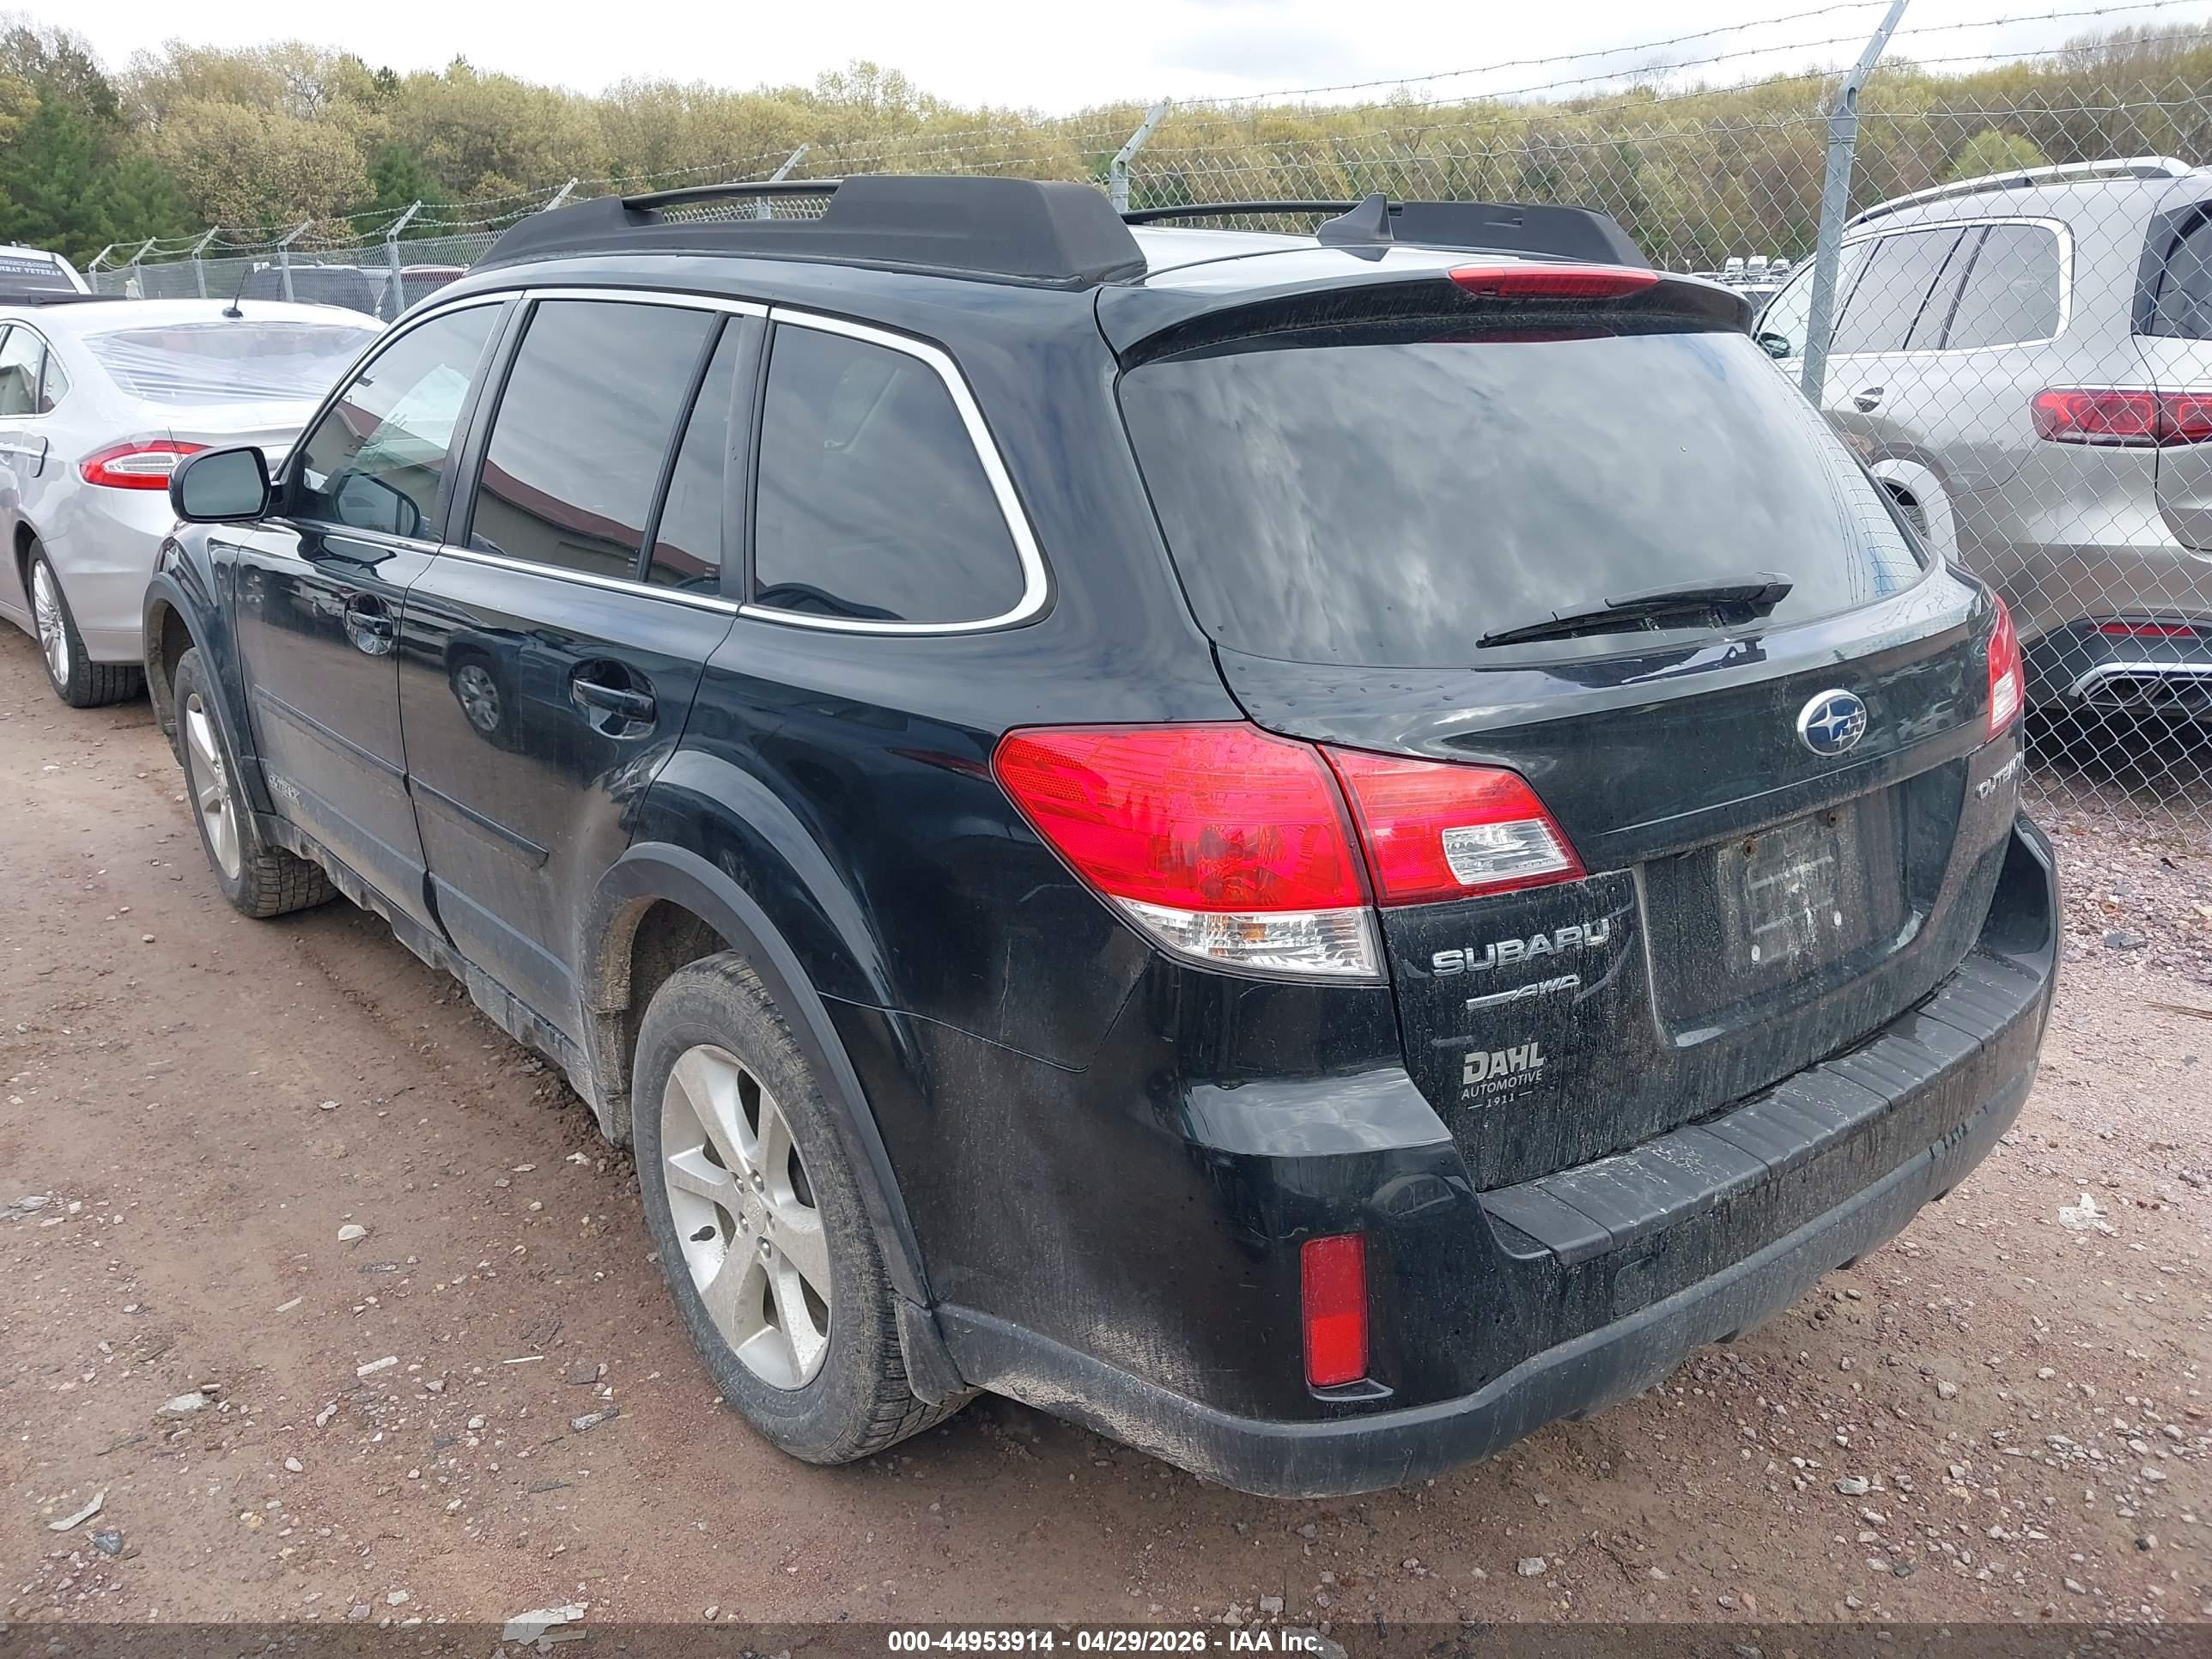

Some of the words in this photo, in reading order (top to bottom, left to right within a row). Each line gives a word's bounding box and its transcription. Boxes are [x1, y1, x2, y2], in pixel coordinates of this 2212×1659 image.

[1431, 918, 1610, 977] SUBARU
[1511, 974, 1581, 1001] AWD
[1462, 1041, 1546, 1085] DAHL
[1461, 1069, 1543, 1101] AUTOMOTIVE
[1486, 1092, 1515, 1109] 1911
